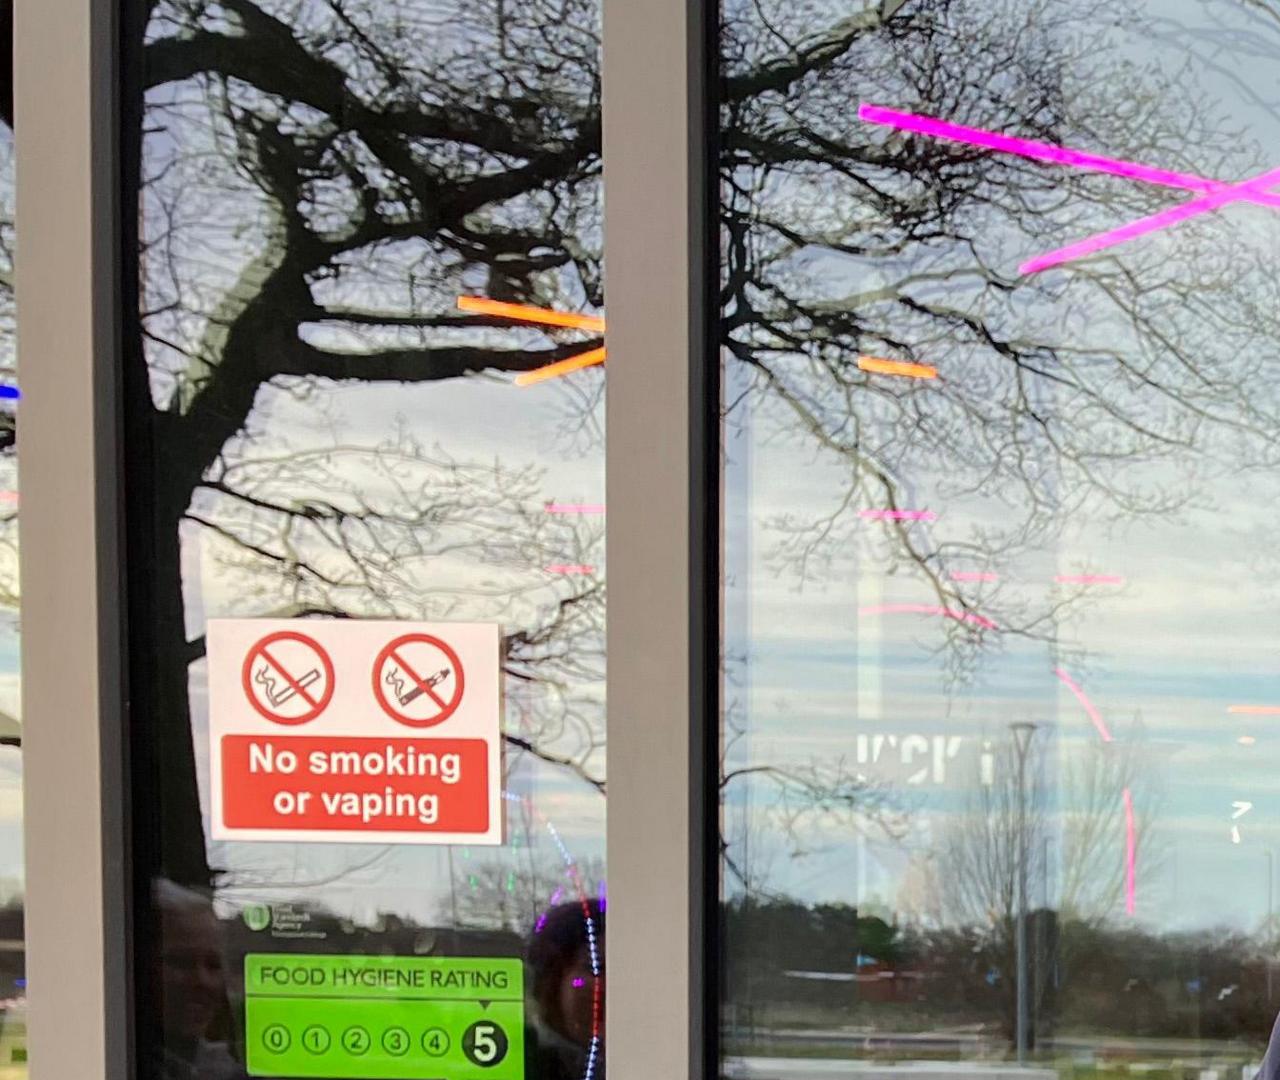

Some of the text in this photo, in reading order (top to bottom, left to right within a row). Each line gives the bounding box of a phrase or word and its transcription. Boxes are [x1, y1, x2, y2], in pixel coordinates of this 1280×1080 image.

[249, 743, 461, 784] No smoking
[273, 787, 439, 824] or vaping
[260, 966, 508, 989] FOOD HYGIENE RATING
[270, 1026, 497, 1062] 0 1 2 3 4 5
